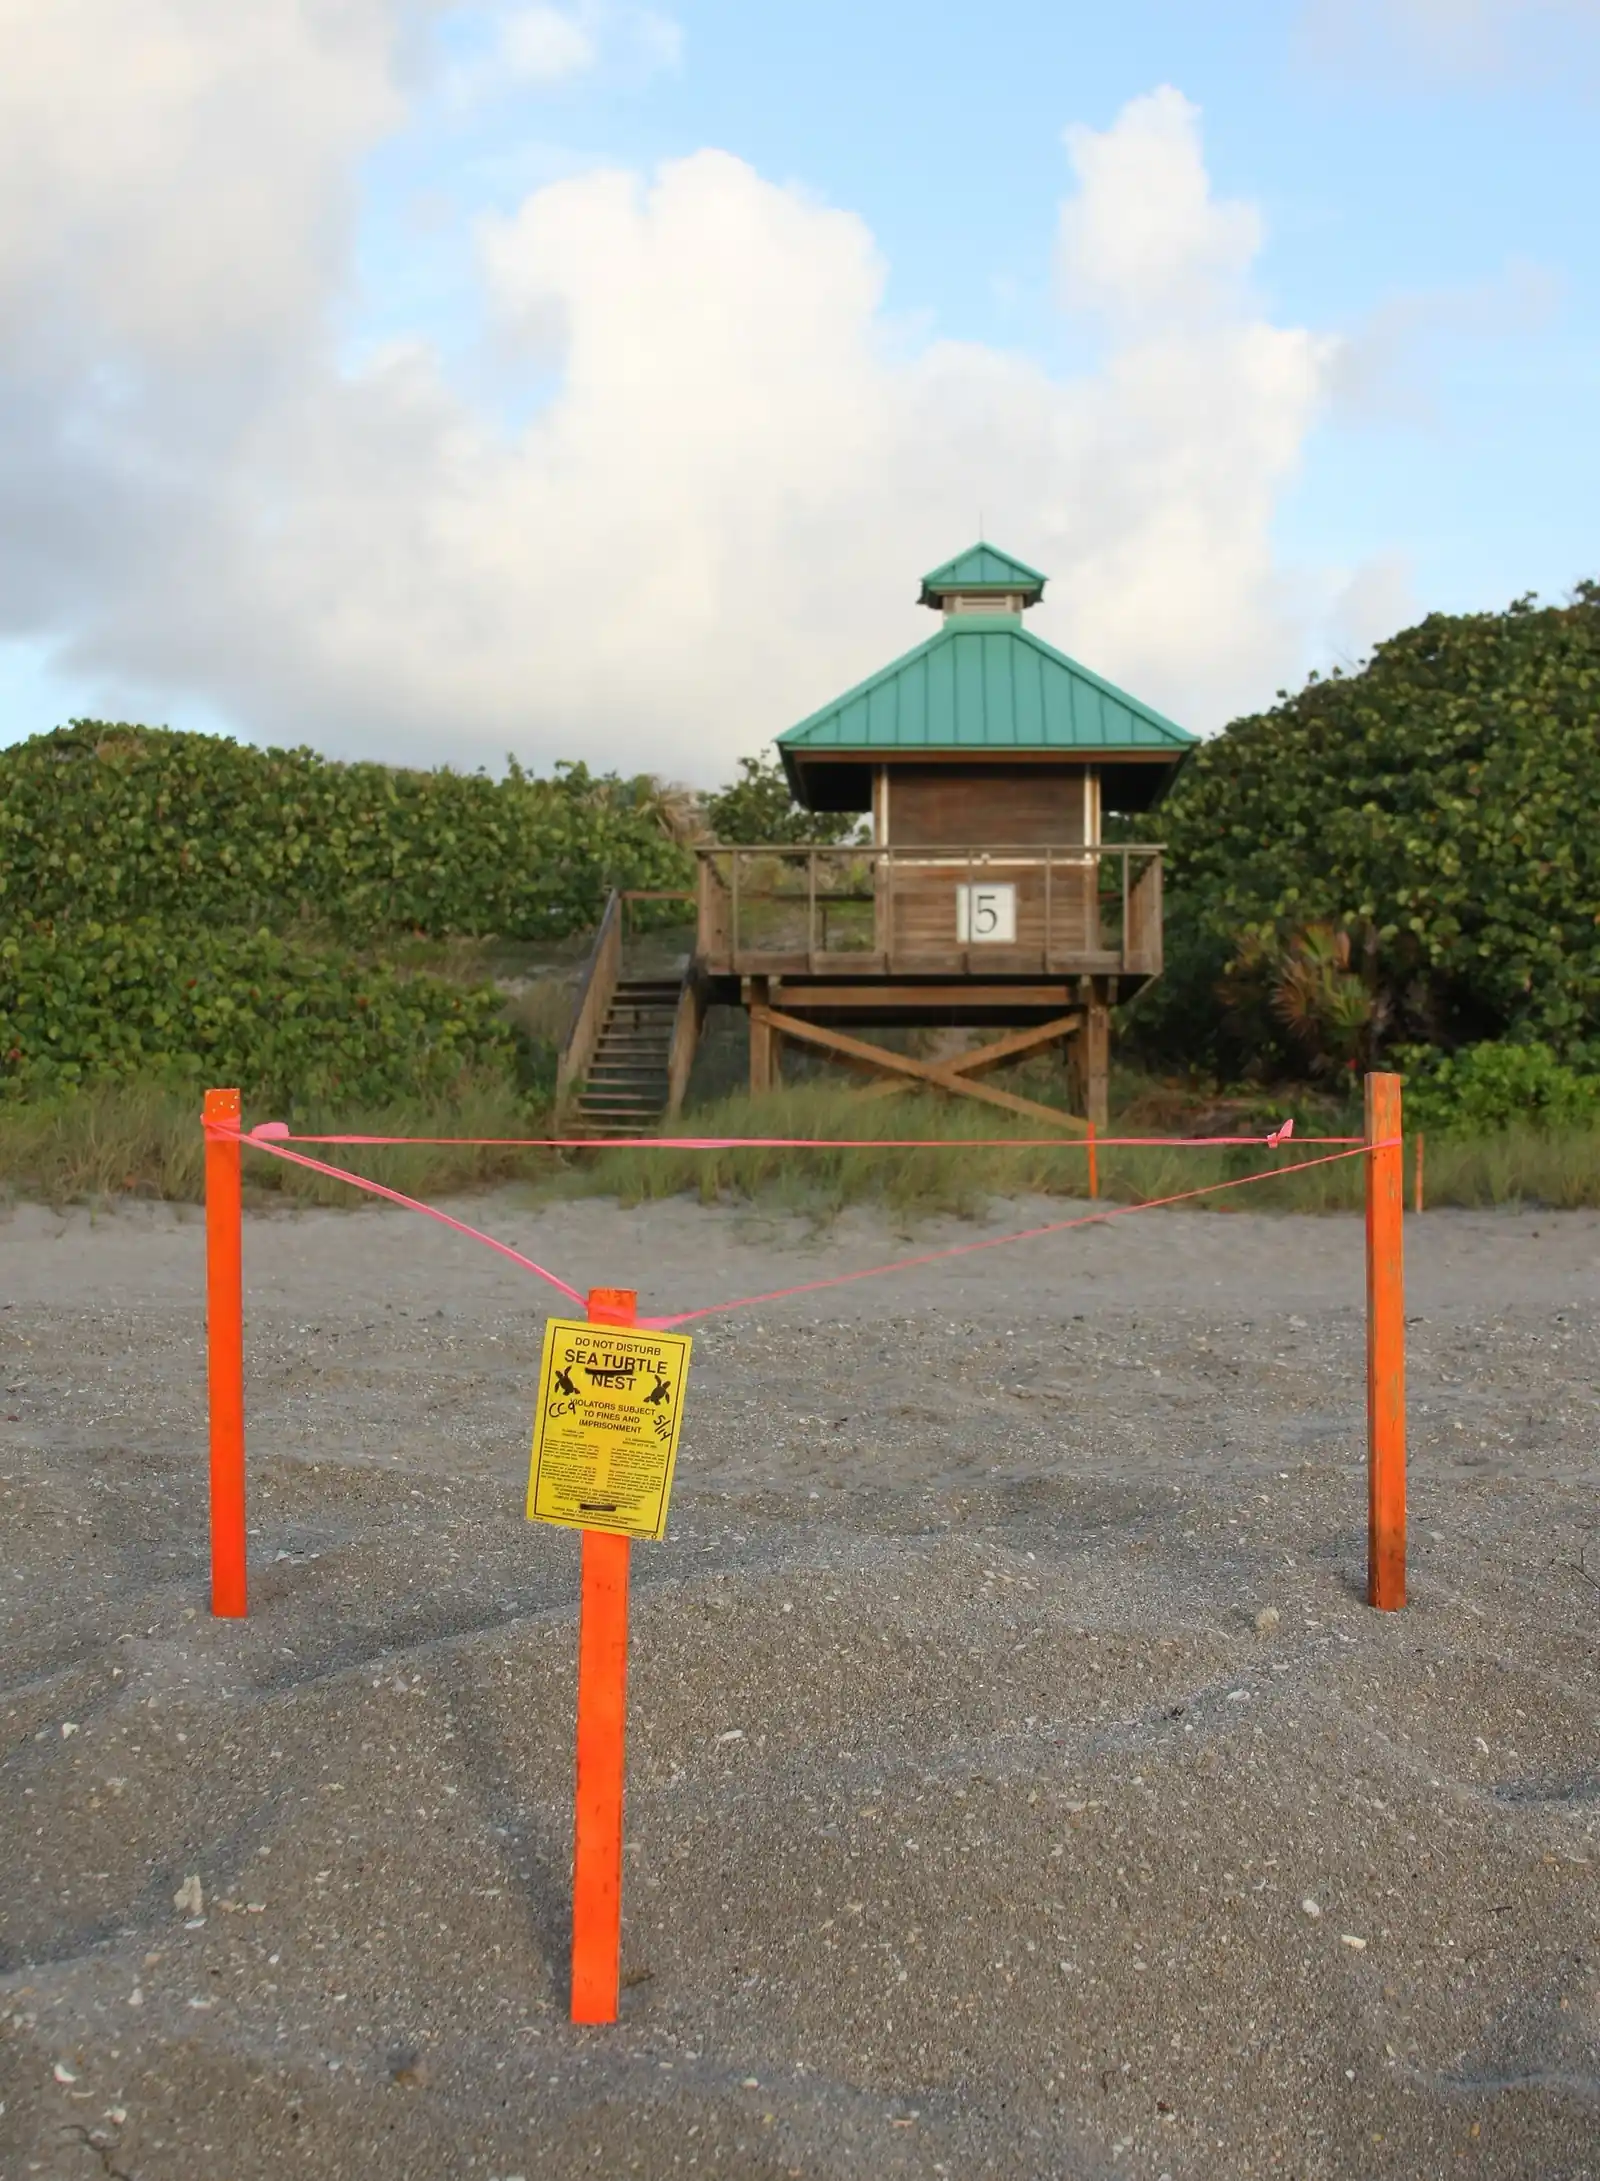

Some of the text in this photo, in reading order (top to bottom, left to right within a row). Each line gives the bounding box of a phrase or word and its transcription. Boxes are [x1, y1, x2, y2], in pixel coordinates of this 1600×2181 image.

[976, 895, 998, 934] 5
[575, 1337, 661, 1356] DO NOT DISTURB
[565, 1349, 668, 1374] SEA TURTLE
[592, 1374, 637, 1391] NEST
[571, 1398, 656, 1416] VIOLATORS SUBJECT
[583, 1409, 640, 1424] TO FINES AND
[579, 1419, 642, 1434] IMPRISONMENT
